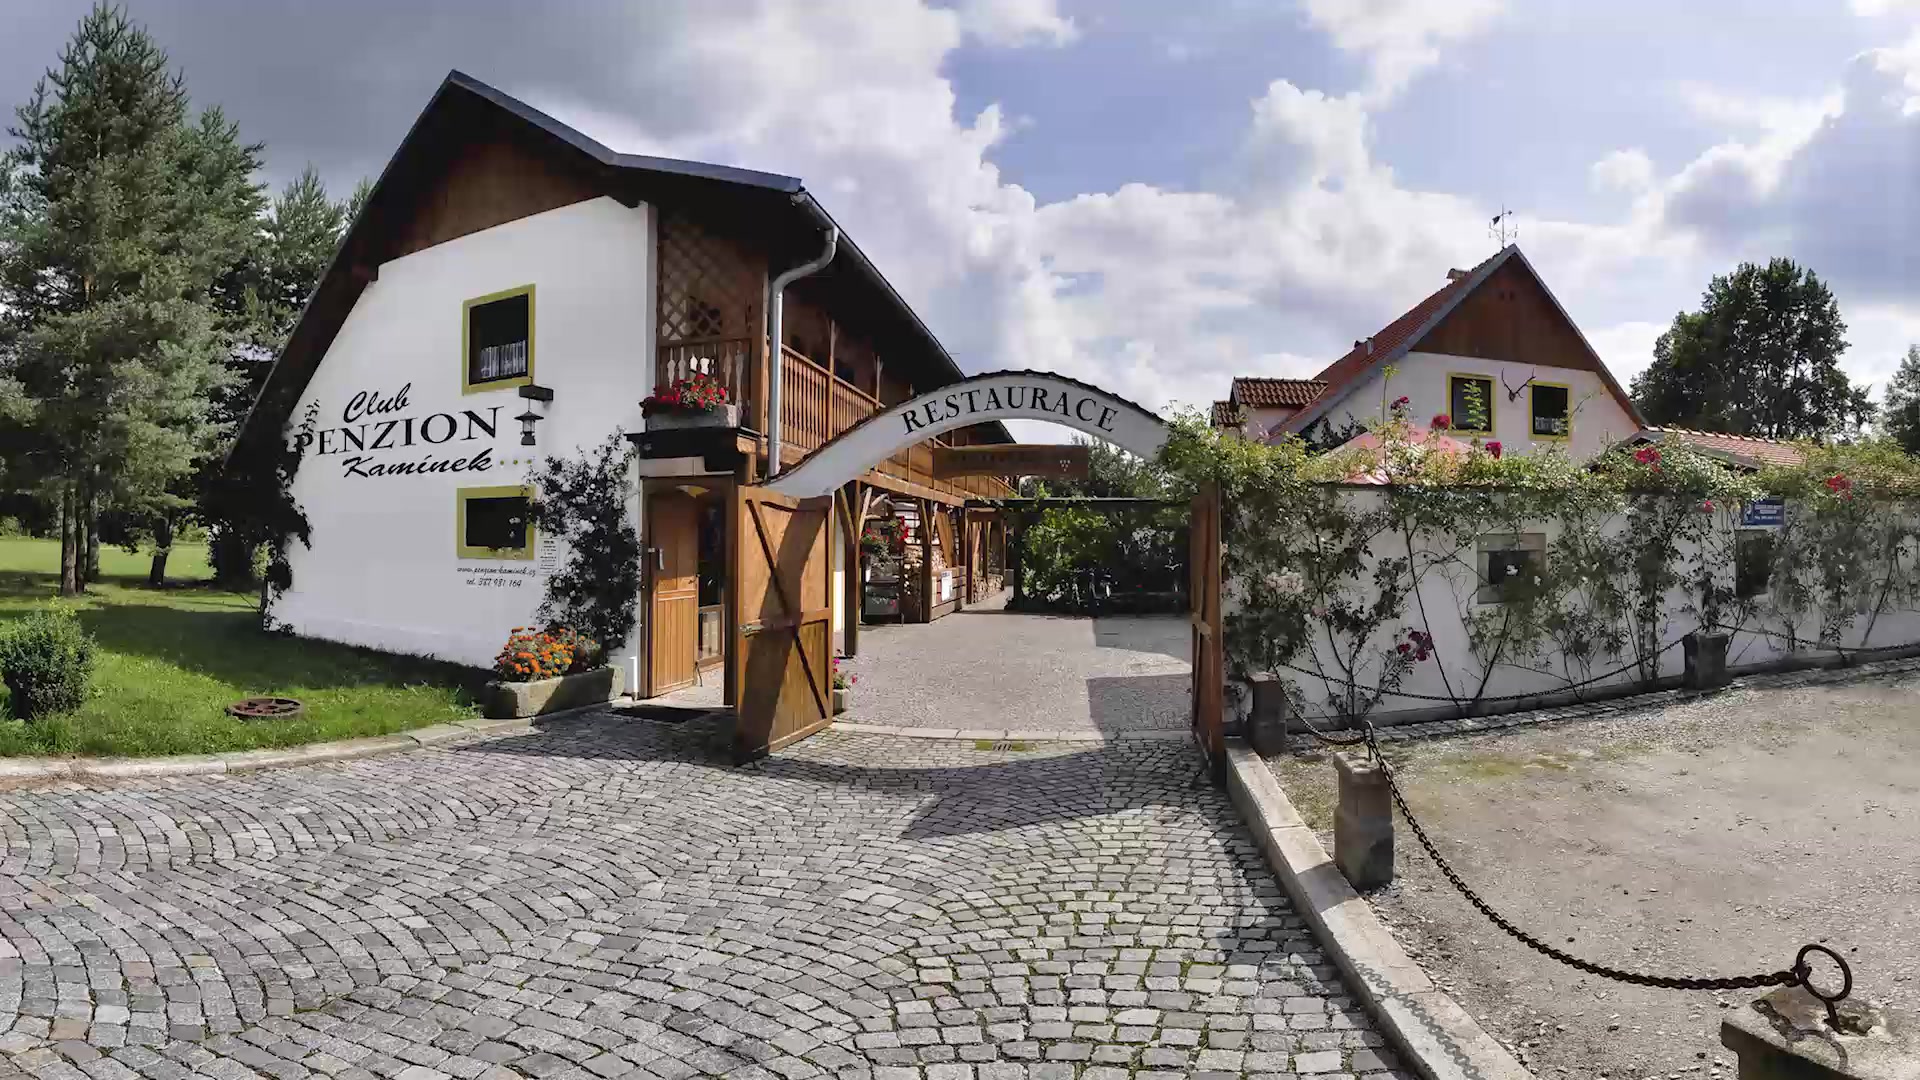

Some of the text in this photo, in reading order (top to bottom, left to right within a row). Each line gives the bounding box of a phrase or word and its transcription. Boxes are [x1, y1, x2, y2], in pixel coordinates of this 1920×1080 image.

[343, 383, 411, 423] Club
[901, 386, 1119, 435] RESTAURACE
[294, 406, 504, 456] PENZION
